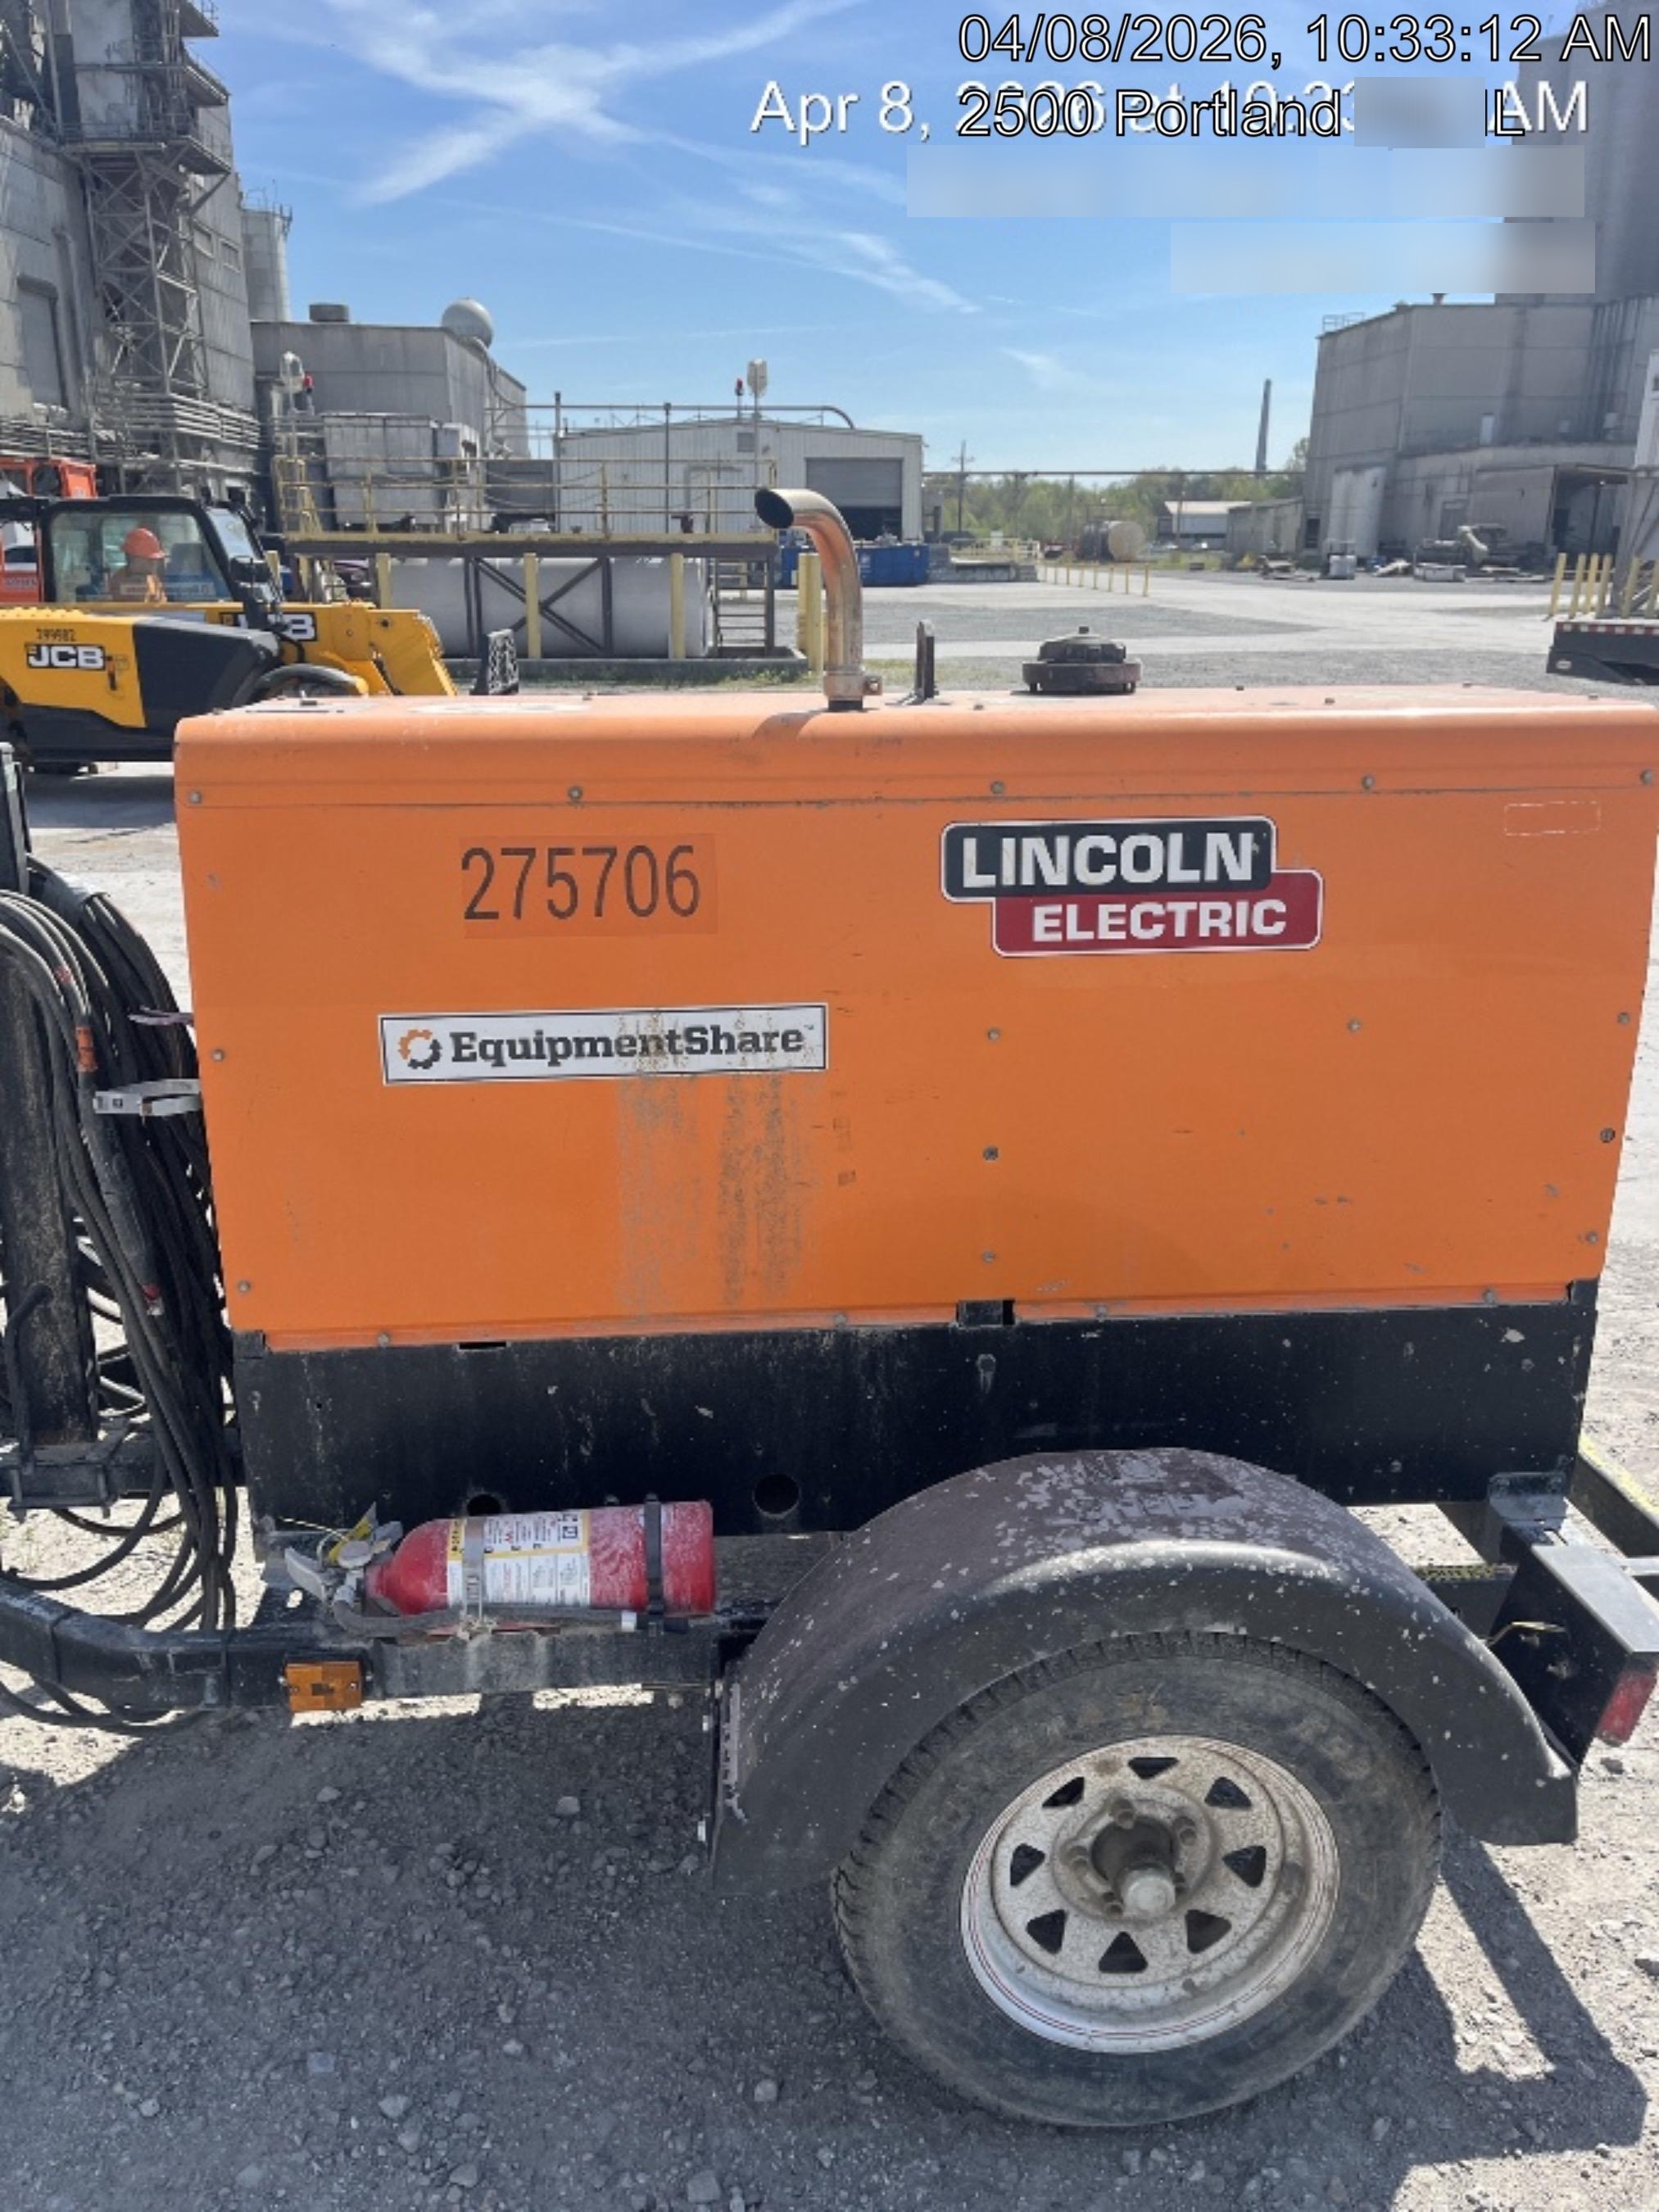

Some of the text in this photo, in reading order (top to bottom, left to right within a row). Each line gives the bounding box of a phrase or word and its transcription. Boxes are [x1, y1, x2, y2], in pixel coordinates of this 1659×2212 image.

[27, 646, 104, 669] JCB
[962, 832, 1254, 889] LINCOLN
[460, 845, 700, 920] 275706
[1031, 899, 1287, 942] ELECTRIC
[450, 1024, 804, 1067] EquipmentShare
